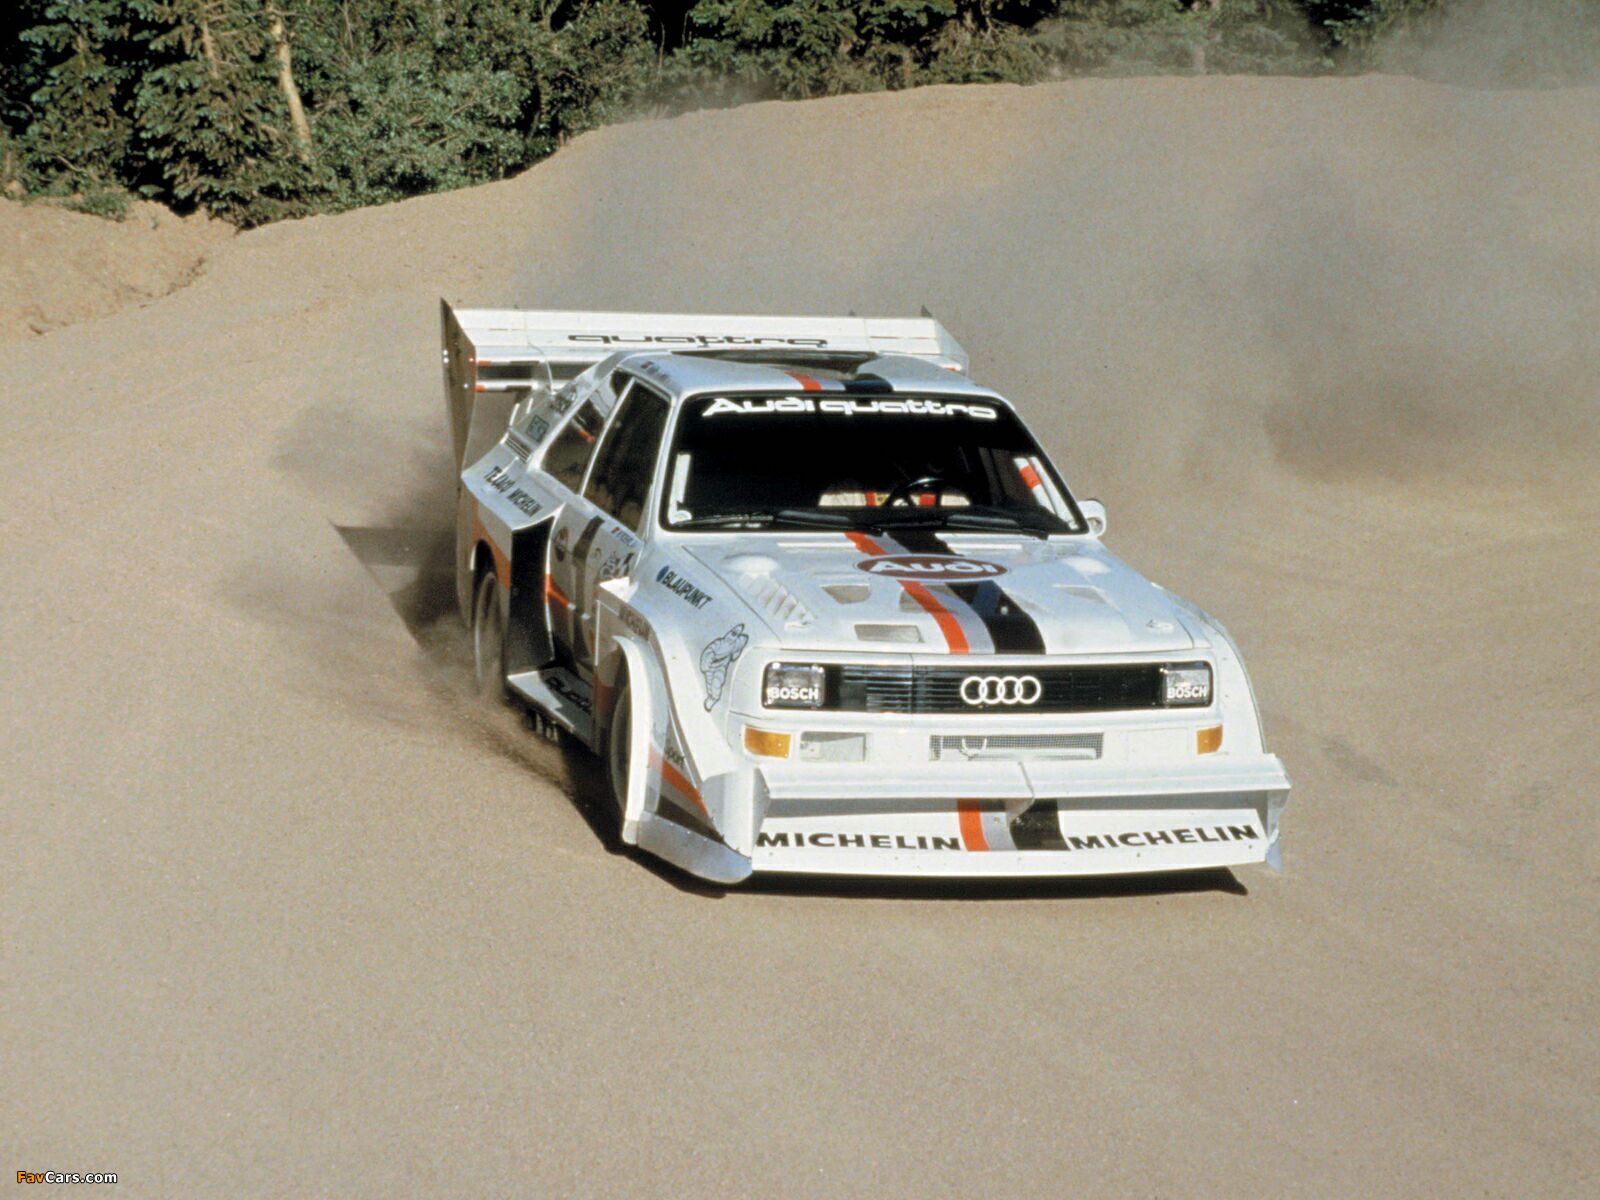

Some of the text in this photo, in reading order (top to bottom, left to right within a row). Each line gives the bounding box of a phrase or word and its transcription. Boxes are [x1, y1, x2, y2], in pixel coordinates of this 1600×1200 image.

[567, 334, 828, 348] quattro
[702, 396, 998, 420] Audi quattro
[507, 488, 543, 518] MICHELIN
[868, 560, 999, 574] Audi
[660, 570, 714, 611] BLAUPUNKT
[766, 687, 820, 701] BOSCH
[1166, 685, 1207, 699] BOSCH
[755, 831, 961, 851] MICHELIN
[1067, 824, 1260, 850] MICHELIN
